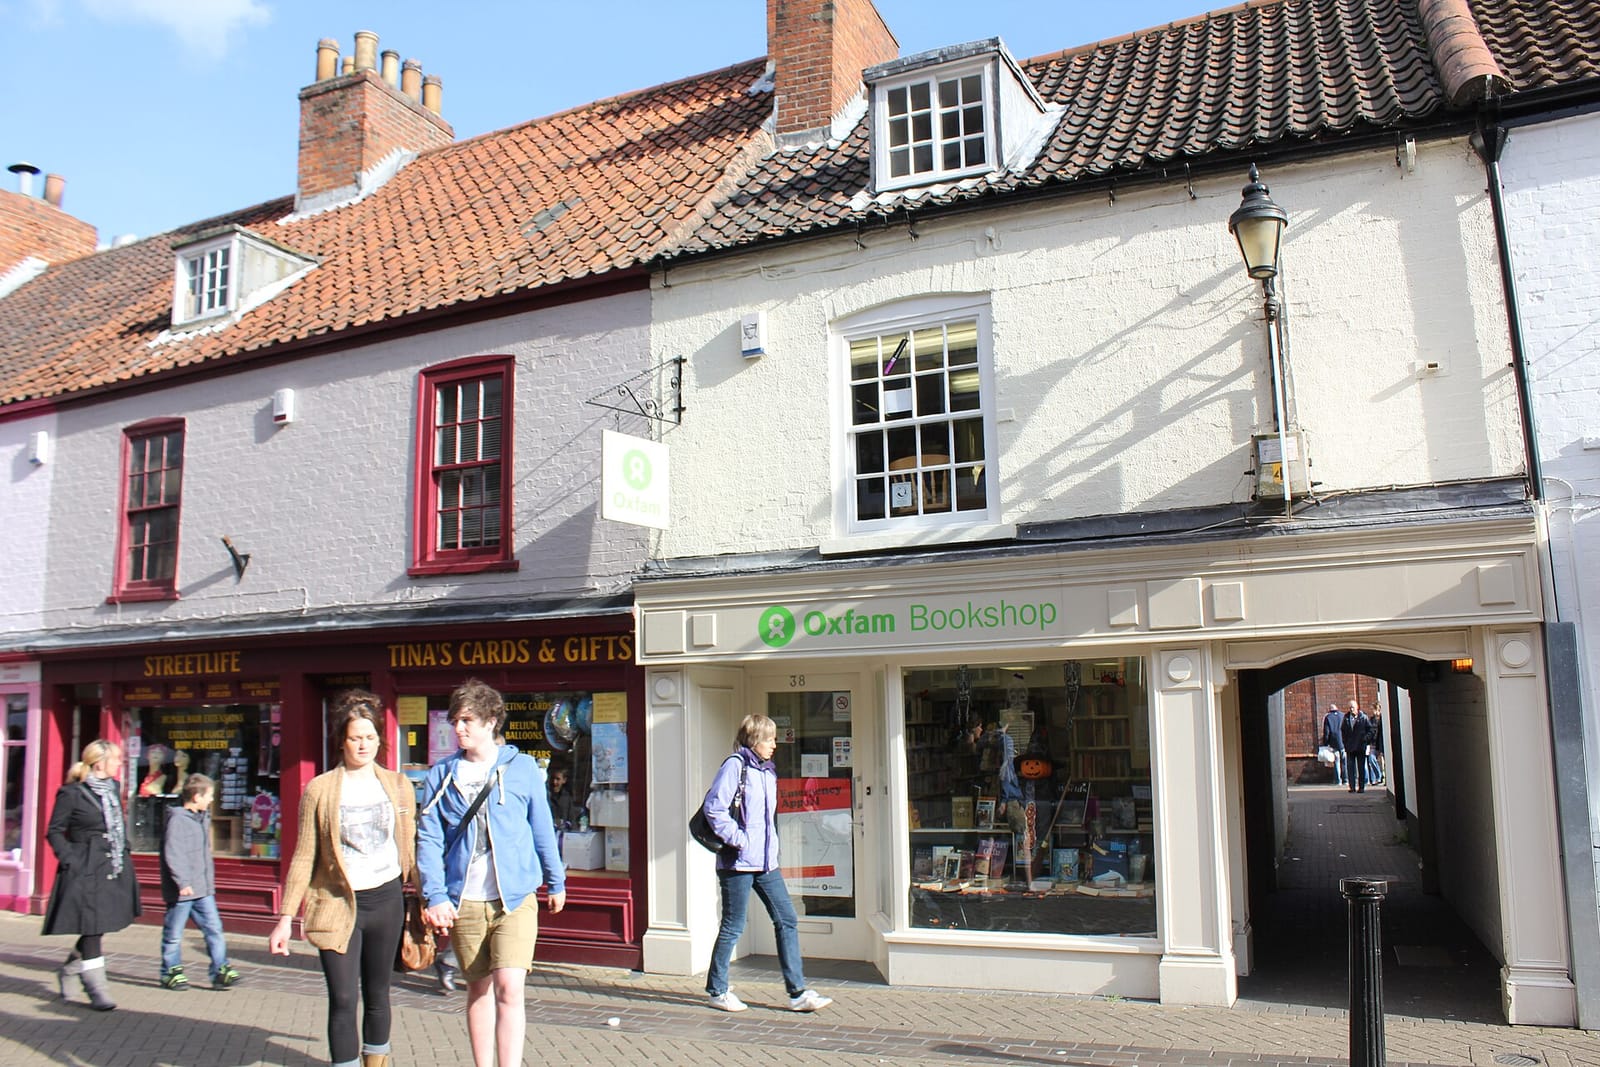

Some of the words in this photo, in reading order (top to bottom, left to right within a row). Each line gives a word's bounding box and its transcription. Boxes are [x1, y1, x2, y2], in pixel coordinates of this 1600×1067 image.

[613, 492, 661, 516] Oxfam
[804, 609, 895, 636] Oxfam
[909, 600, 1057, 631] Bookshop
[387, 642, 452, 668] TINA'S
[459, 639, 530, 665] CARDS
[538, 638, 556, 662] &
[564, 635, 632, 662] GIFTS
[143, 651, 241, 677] STREETLIFE
[790, 674, 806, 687] 38
[505, 731, 543, 740] BALLOONS
[510, 720, 538, 730] HELIUM
